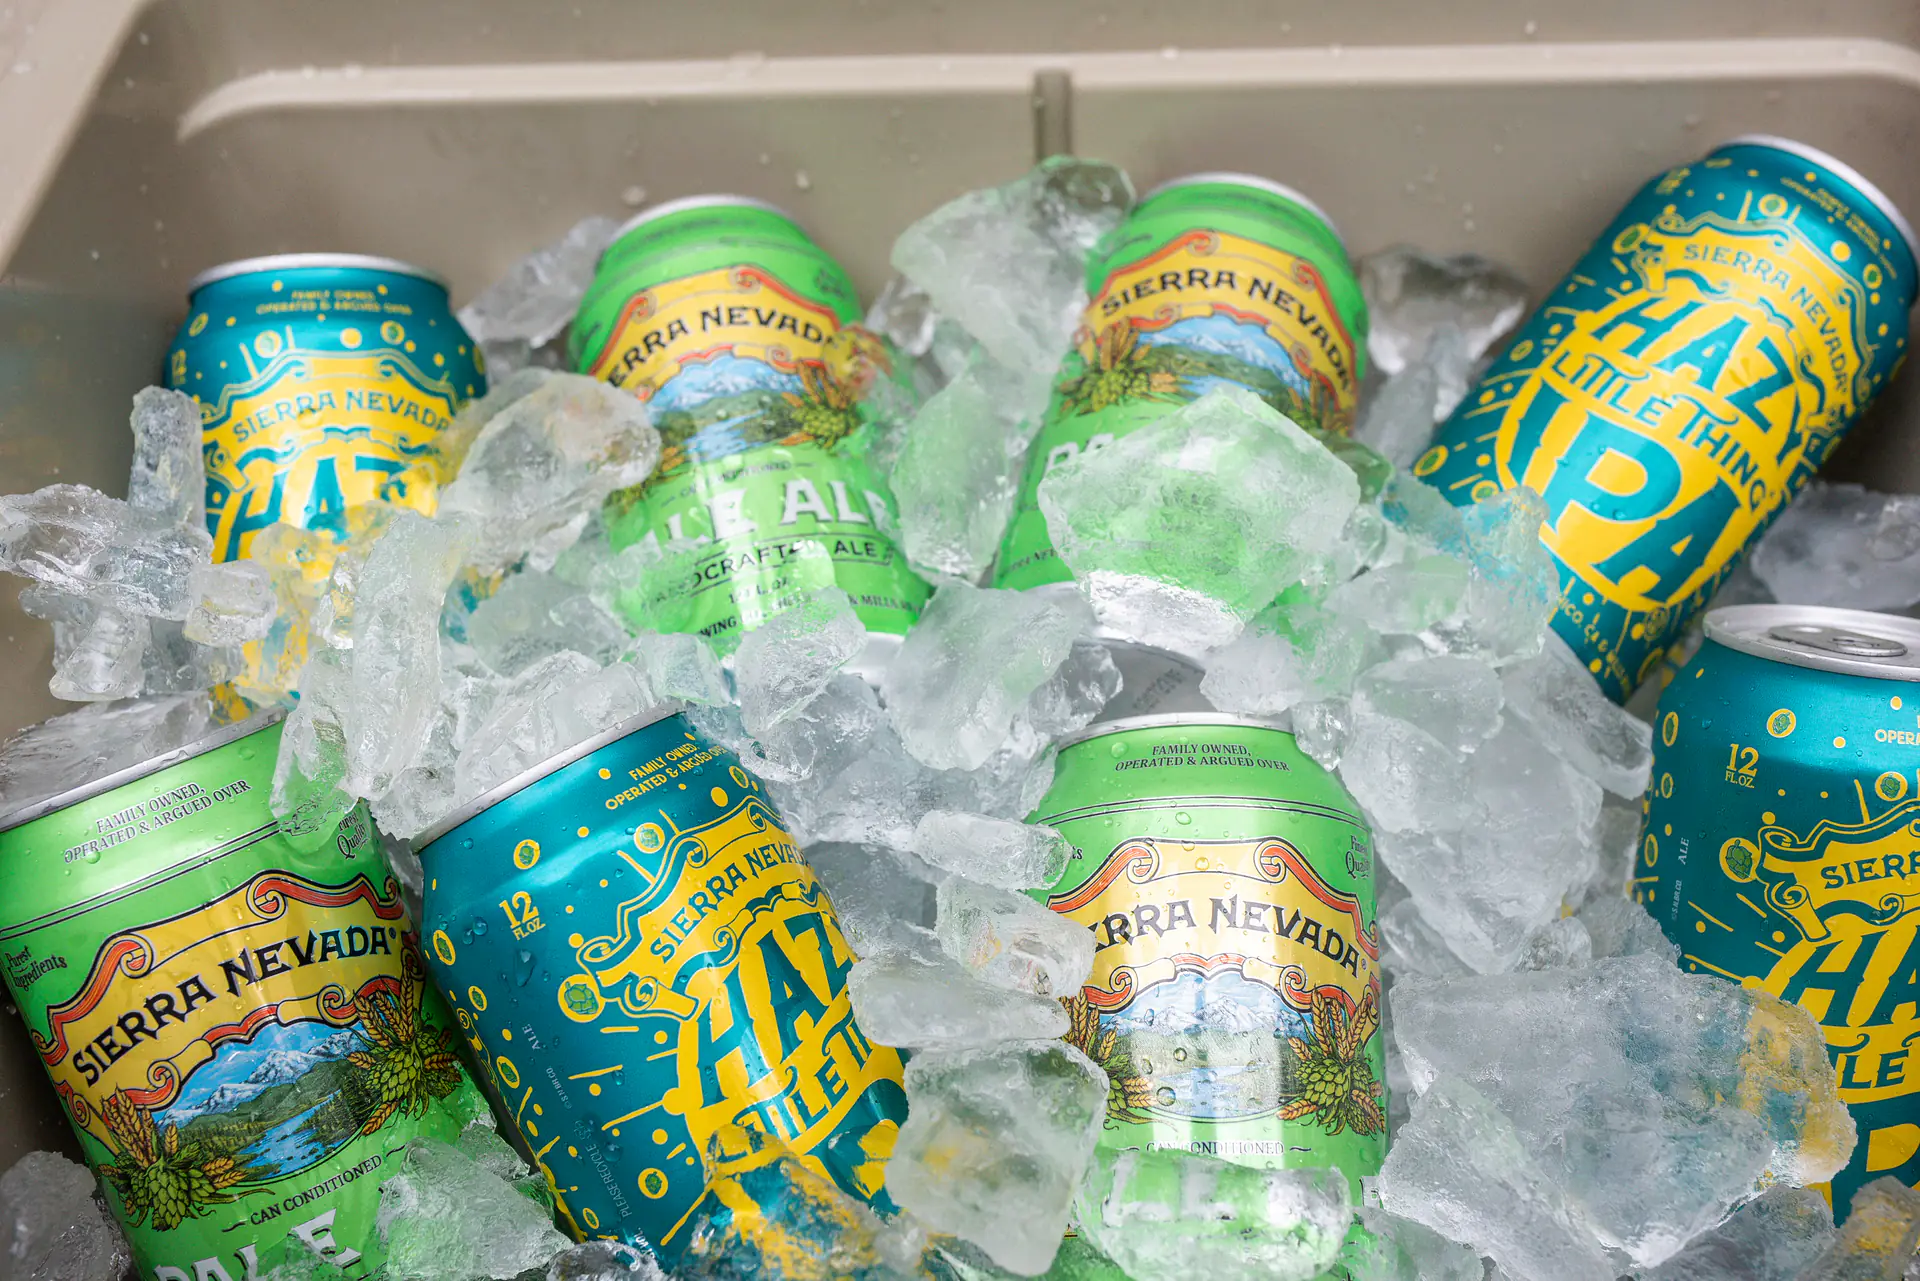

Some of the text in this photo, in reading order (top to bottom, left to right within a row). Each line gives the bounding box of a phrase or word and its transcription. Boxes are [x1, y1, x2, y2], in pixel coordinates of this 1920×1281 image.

[1102, 267, 1237, 318] SIERRA
[1683, 243, 1791, 291] SIERRA
[607, 319, 690, 388] ERRA
[1551, 350, 1672, 429] LITTLE
[232, 391, 337, 443] SIERRA
[1672, 393, 1766, 514] THING
[1506, 375, 1743, 604] IPA
[834, 540, 879, 558] ALE
[700, 615, 738, 638] WING
[628, 757, 667, 781] FAMILY
[1115, 756, 1291, 772] OPERATED & ARGUED OVER
[1152, 743, 1251, 757] FAMILY OWNED,
[1726, 743, 1759, 777] 12
[605, 773, 668, 810] OPERATED
[665, 767, 679, 778] &
[677, 751, 713, 773] ARGUED
[64, 779, 252, 863] OPERATED & ARGUED OVER
[96, 782, 206, 833] FAMILY OWNED,
[1678, 837, 1690, 865] ALE
[499, 891, 540, 929] 12
[650, 862, 748, 964] SIERRA
[1208, 893, 1360, 978] NEVADA
[72, 925, 392, 1088] SIERRA NEVADA
[697, 911, 853, 1110] HAZ
[522, 1023, 541, 1050] ALE
[250, 1154, 383, 1225] CAN CONDITIONED
[584, 1143, 632, 1218] PLEASE RECYCLE
